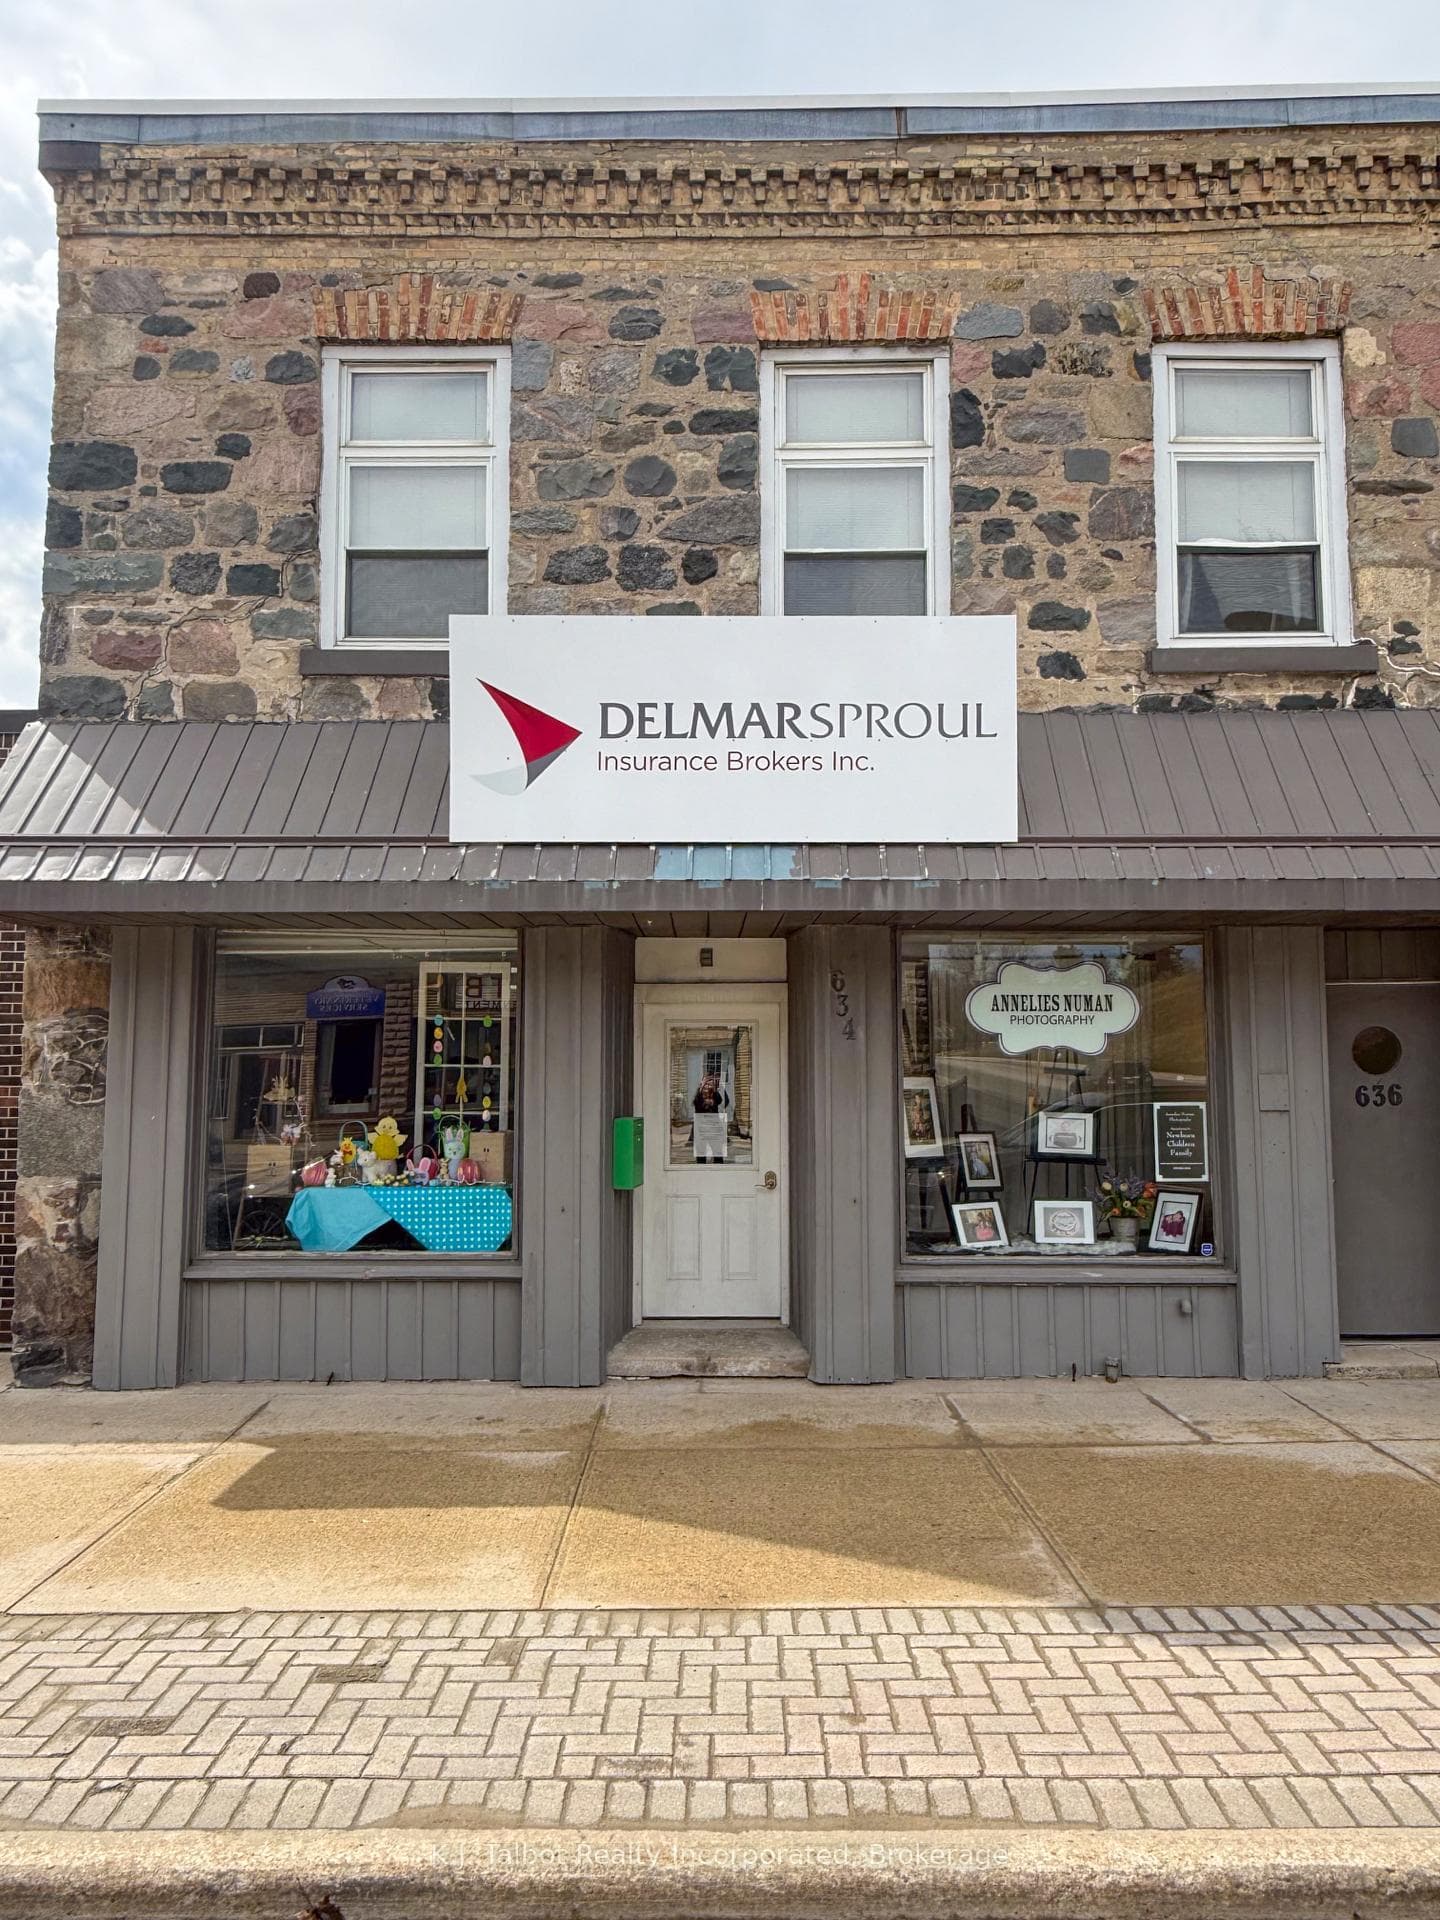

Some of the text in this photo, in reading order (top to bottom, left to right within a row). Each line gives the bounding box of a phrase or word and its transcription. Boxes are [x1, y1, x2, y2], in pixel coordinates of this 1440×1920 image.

[599, 702, 998, 740] DELMARSPROUL
[598, 750, 875, 771] Insurance Brokers Inc.
[991, 994, 1114, 1012] ANNELIES NUMAN
[1009, 1014, 1095, 1025] PHOTOGRAPHY
[1355, 1084, 1403, 1107] 636
